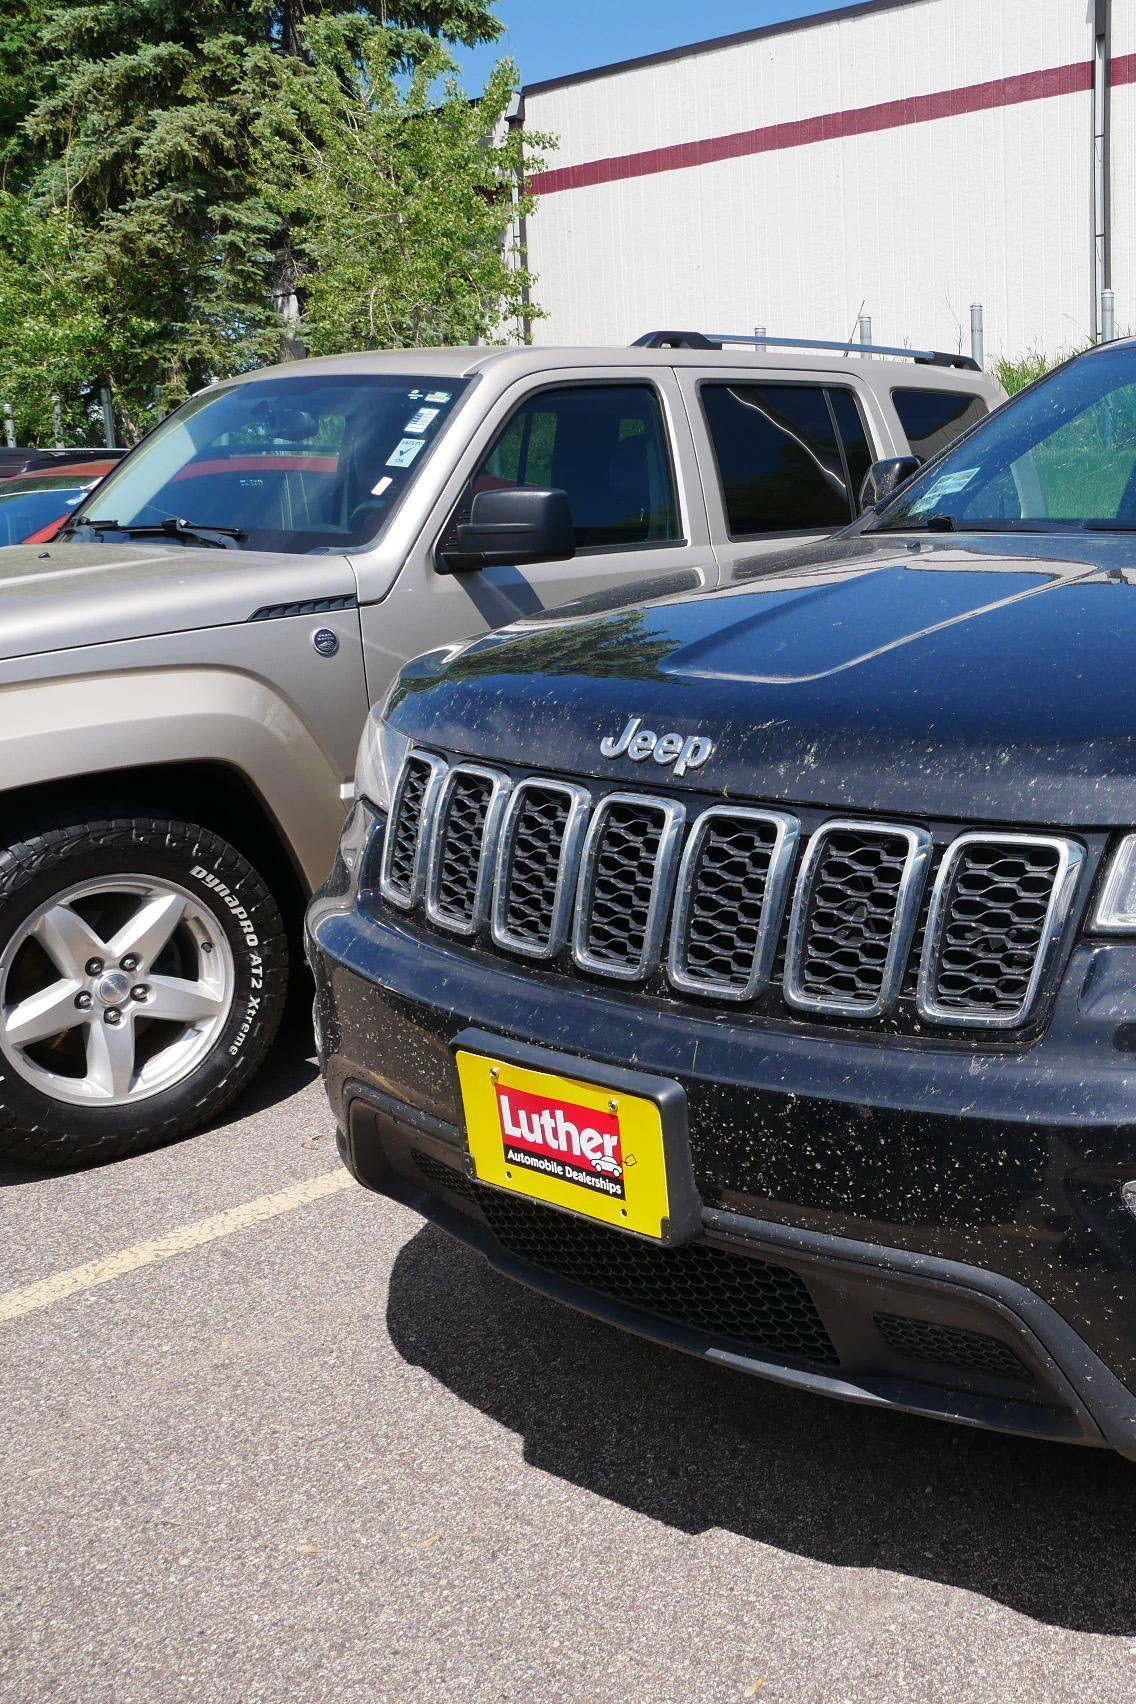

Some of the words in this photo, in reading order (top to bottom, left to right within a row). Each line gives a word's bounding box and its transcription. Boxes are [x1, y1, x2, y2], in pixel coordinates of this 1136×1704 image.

[600, 718, 713, 777] Jeep
[250, 952, 263, 989] AT2
[229, 995, 261, 1056] Xtreme
[499, 1094, 619, 1160] Luther
[507, 1149, 564, 1176] Automobile
[564, 1166, 622, 1195] Dealerships
